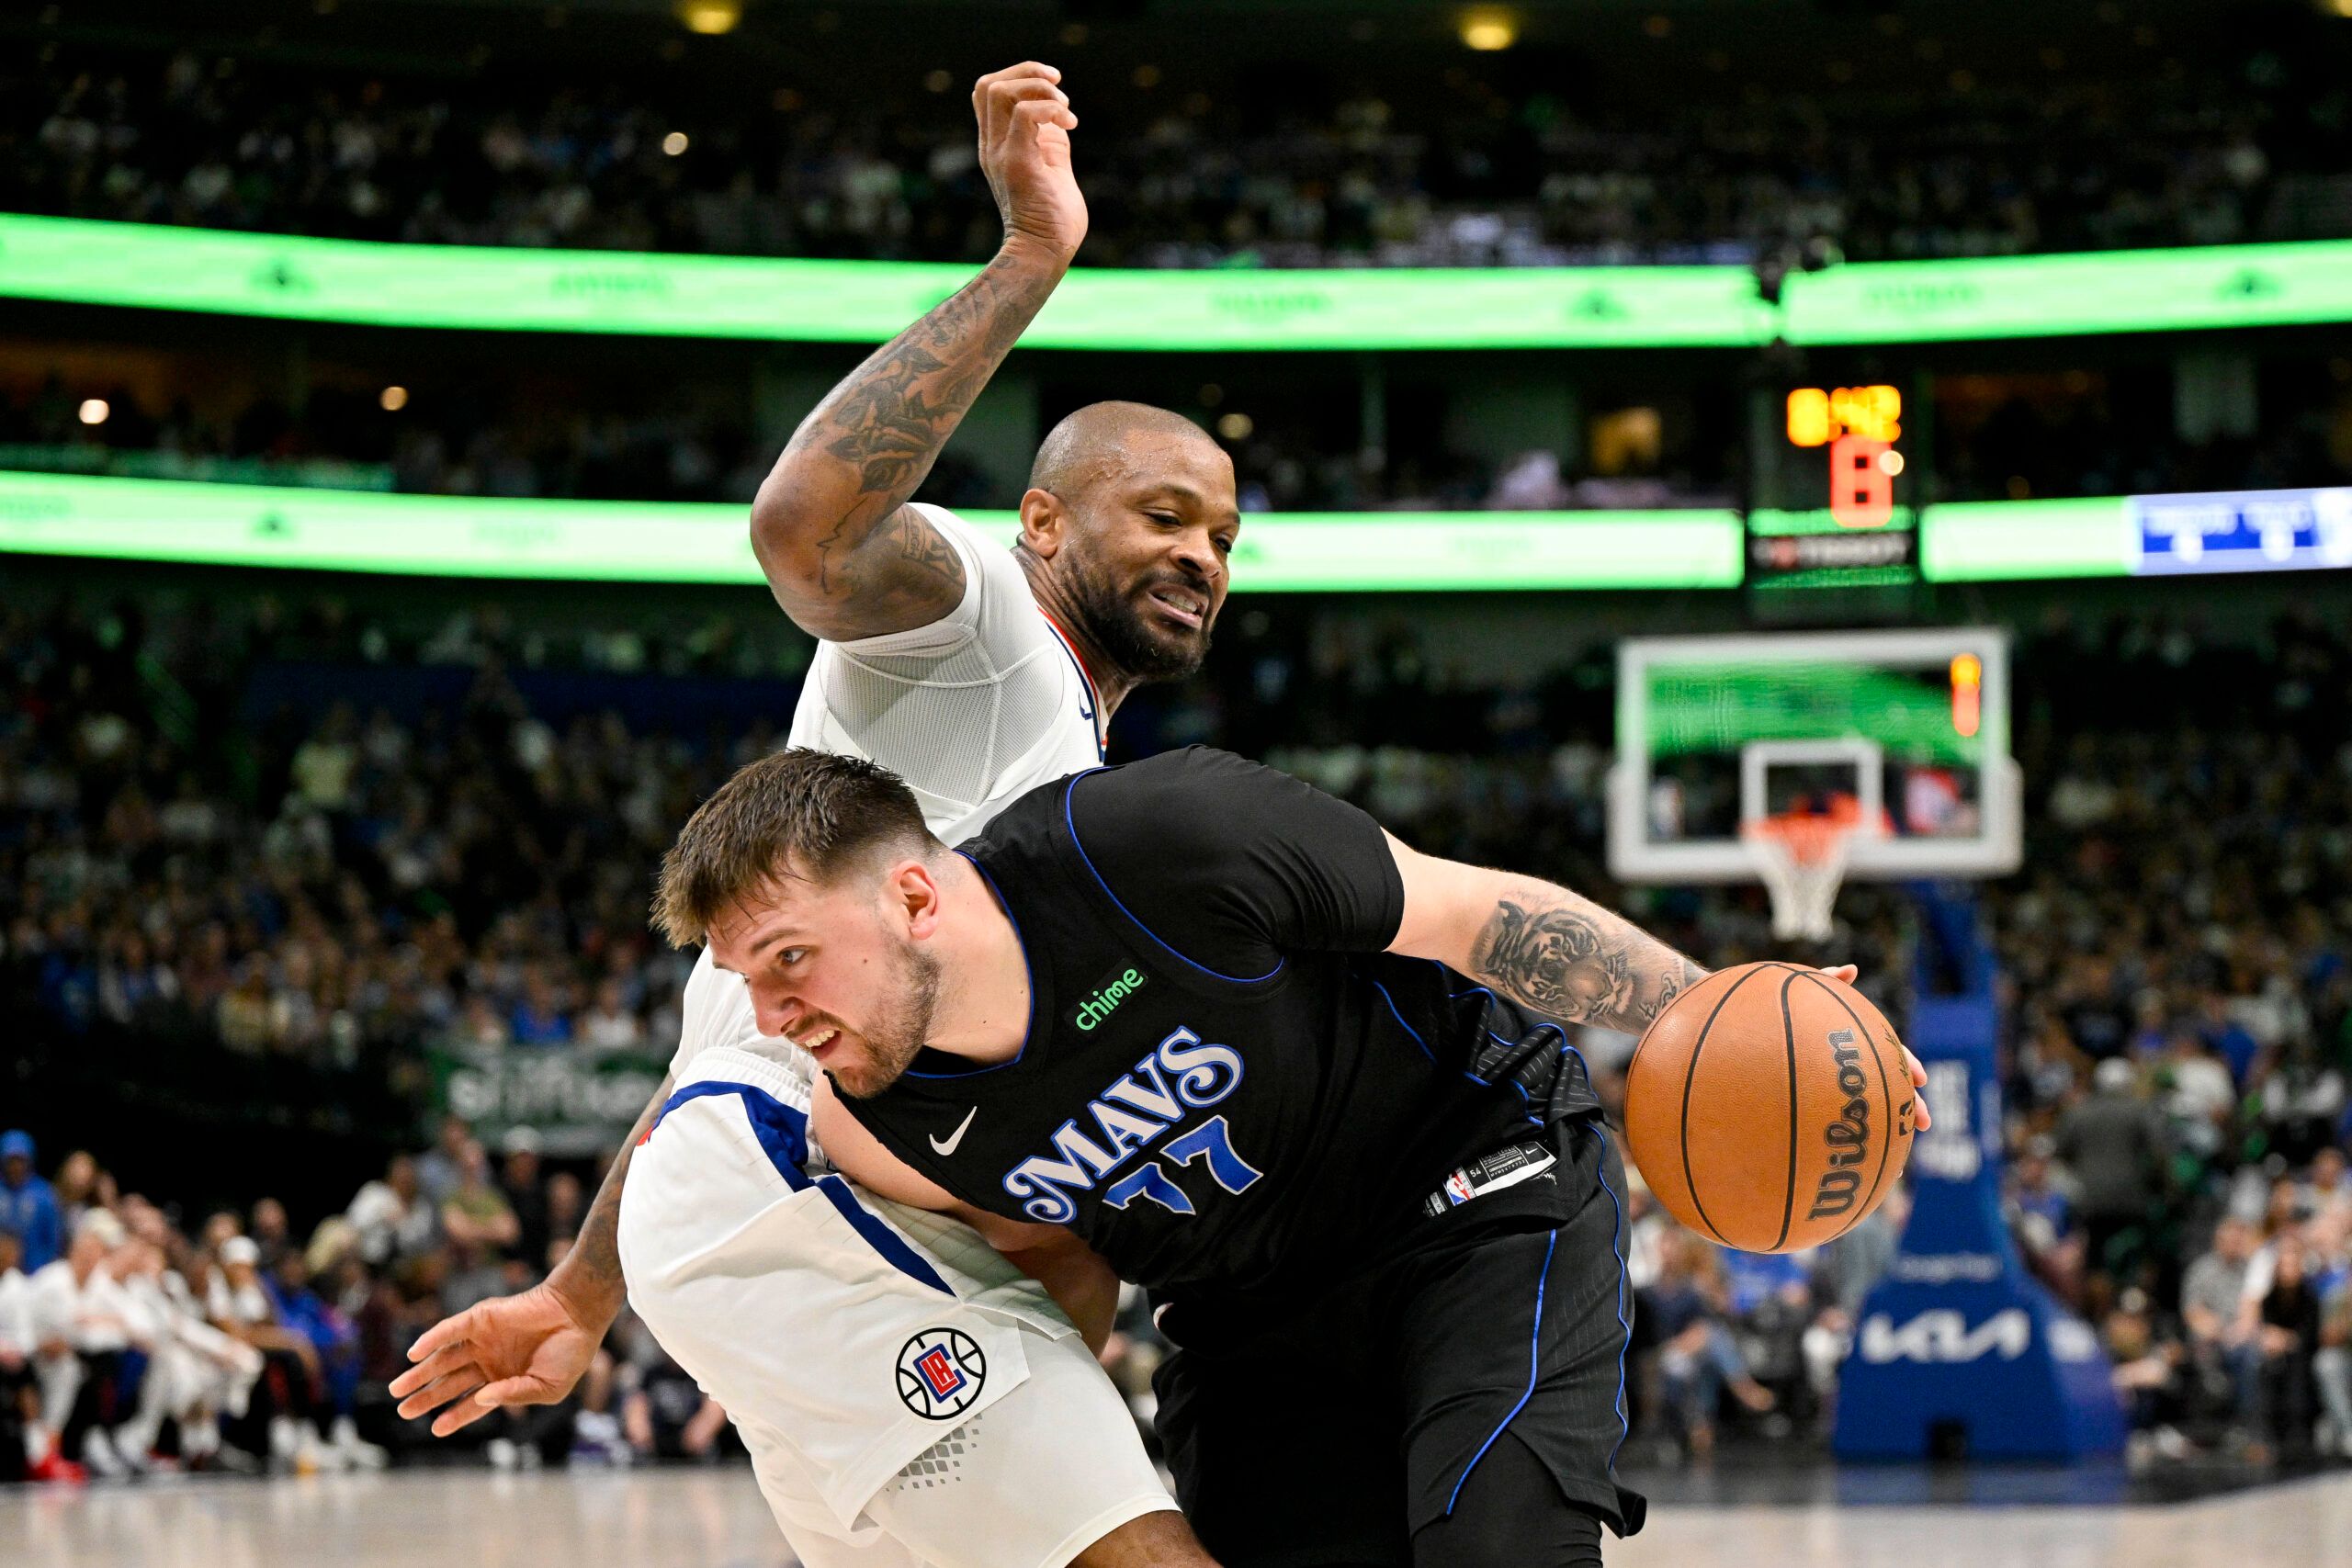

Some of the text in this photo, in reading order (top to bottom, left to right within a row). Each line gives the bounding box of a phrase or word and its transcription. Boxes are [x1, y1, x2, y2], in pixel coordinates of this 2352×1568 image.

[1076, 968, 1144, 1031] chime
[1002, 1025, 1245, 1224] MAVS
[1102, 1114, 1264, 1216] 77
[1804, 1027, 1870, 1222] Wilson
